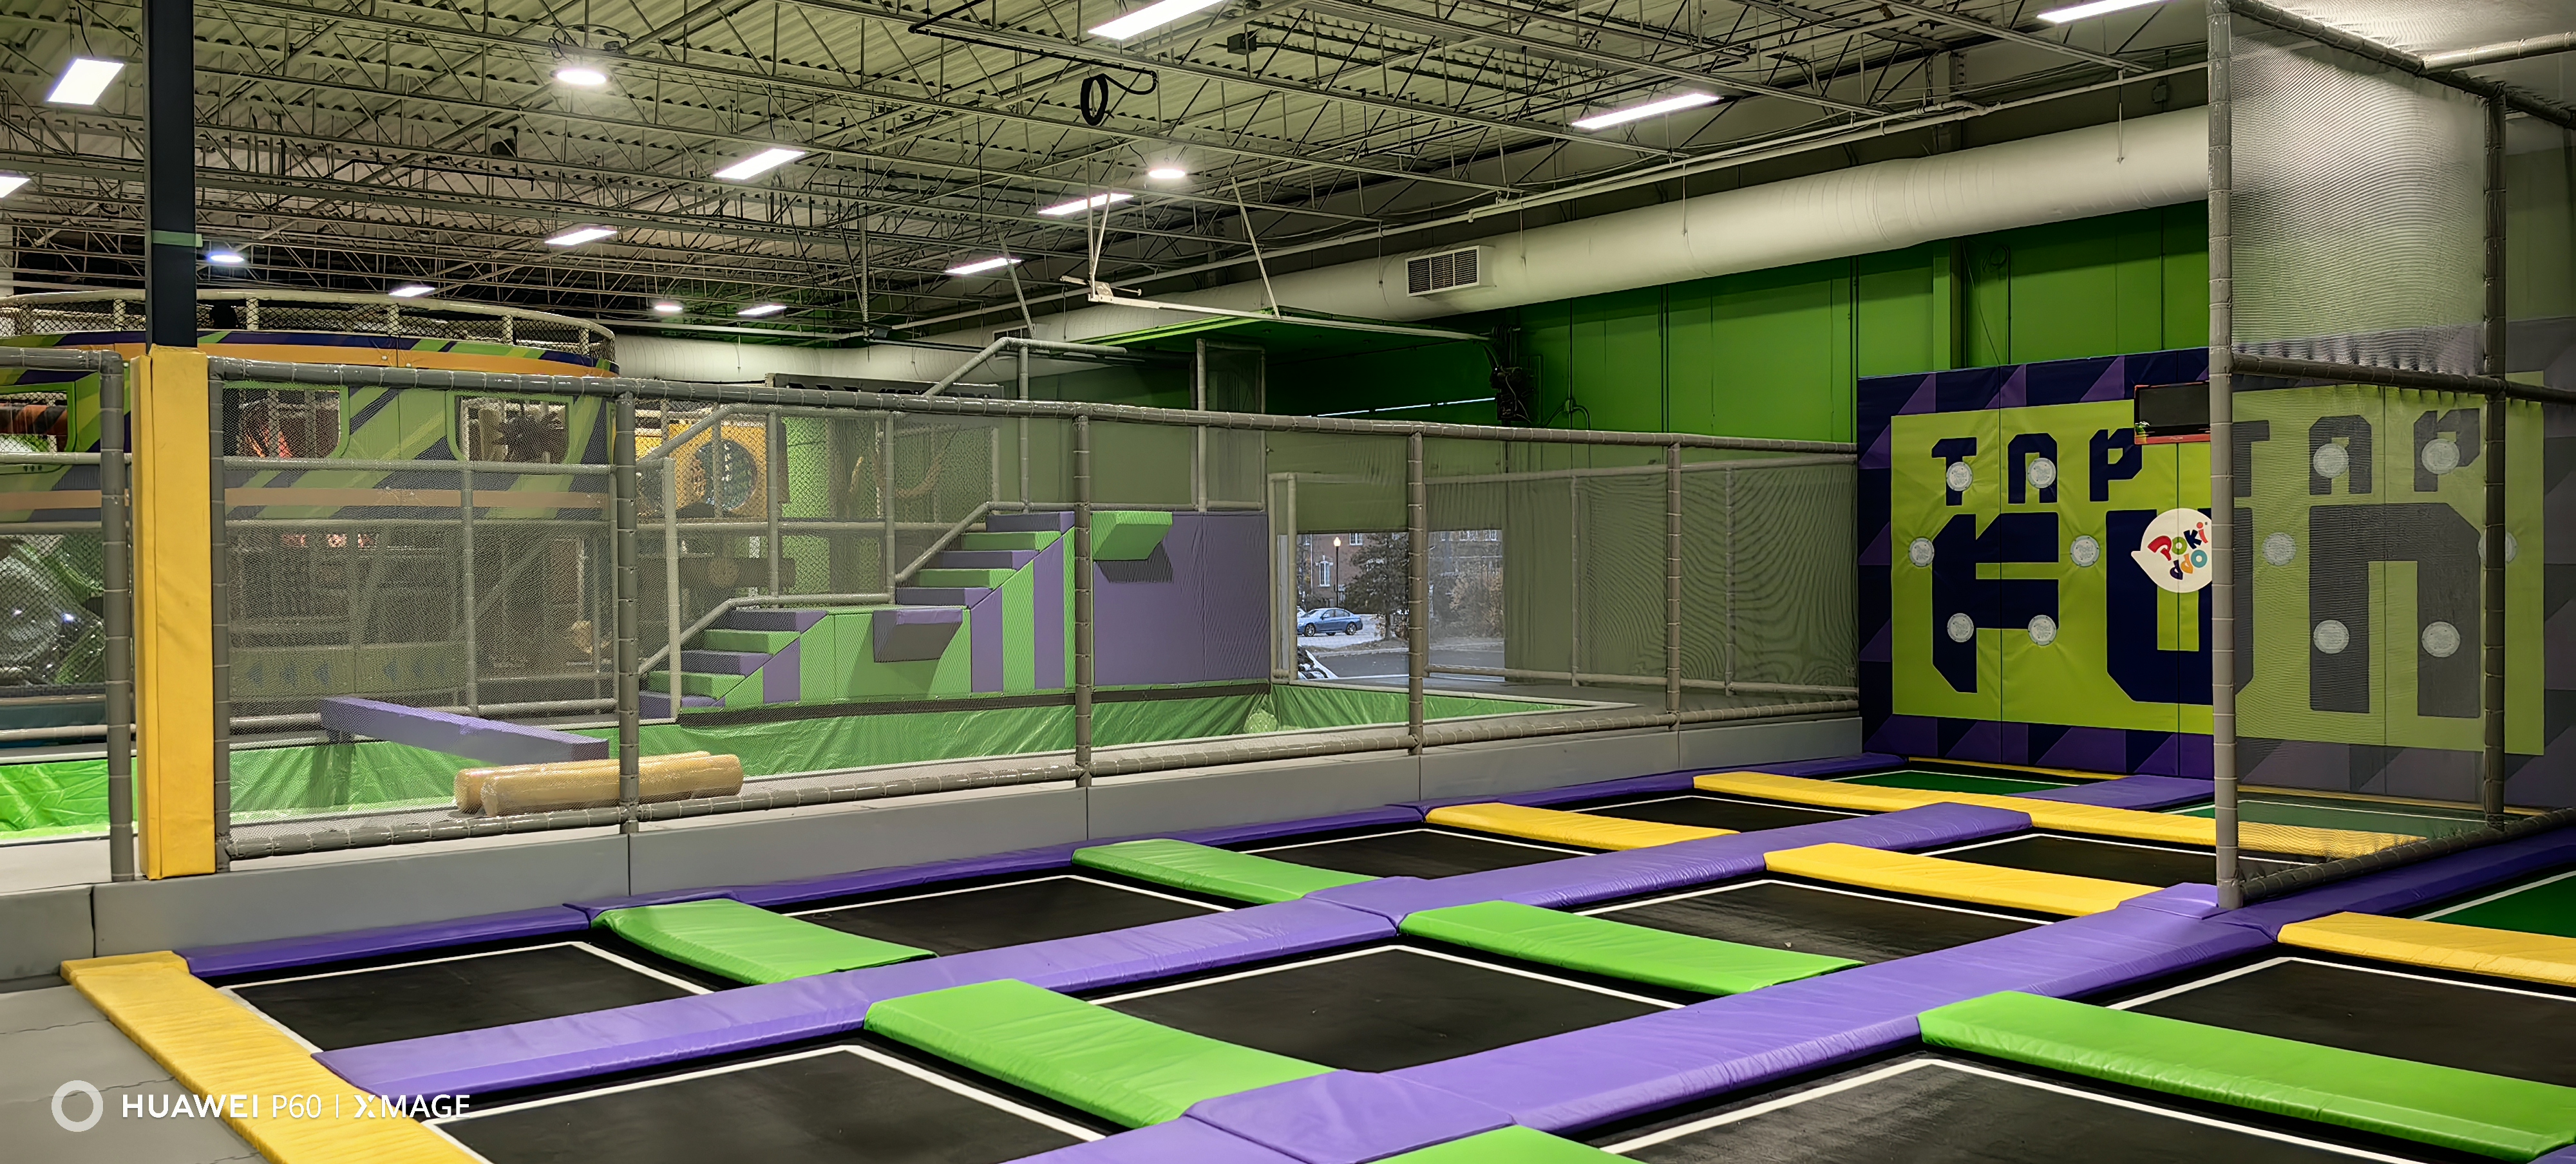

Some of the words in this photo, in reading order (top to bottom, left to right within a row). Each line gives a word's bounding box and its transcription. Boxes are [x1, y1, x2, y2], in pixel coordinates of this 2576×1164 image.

[1931, 427, 2142, 506] TAP
[2232, 408, 2481, 497] TAP
[1931, 502, 2481, 719] FUN
